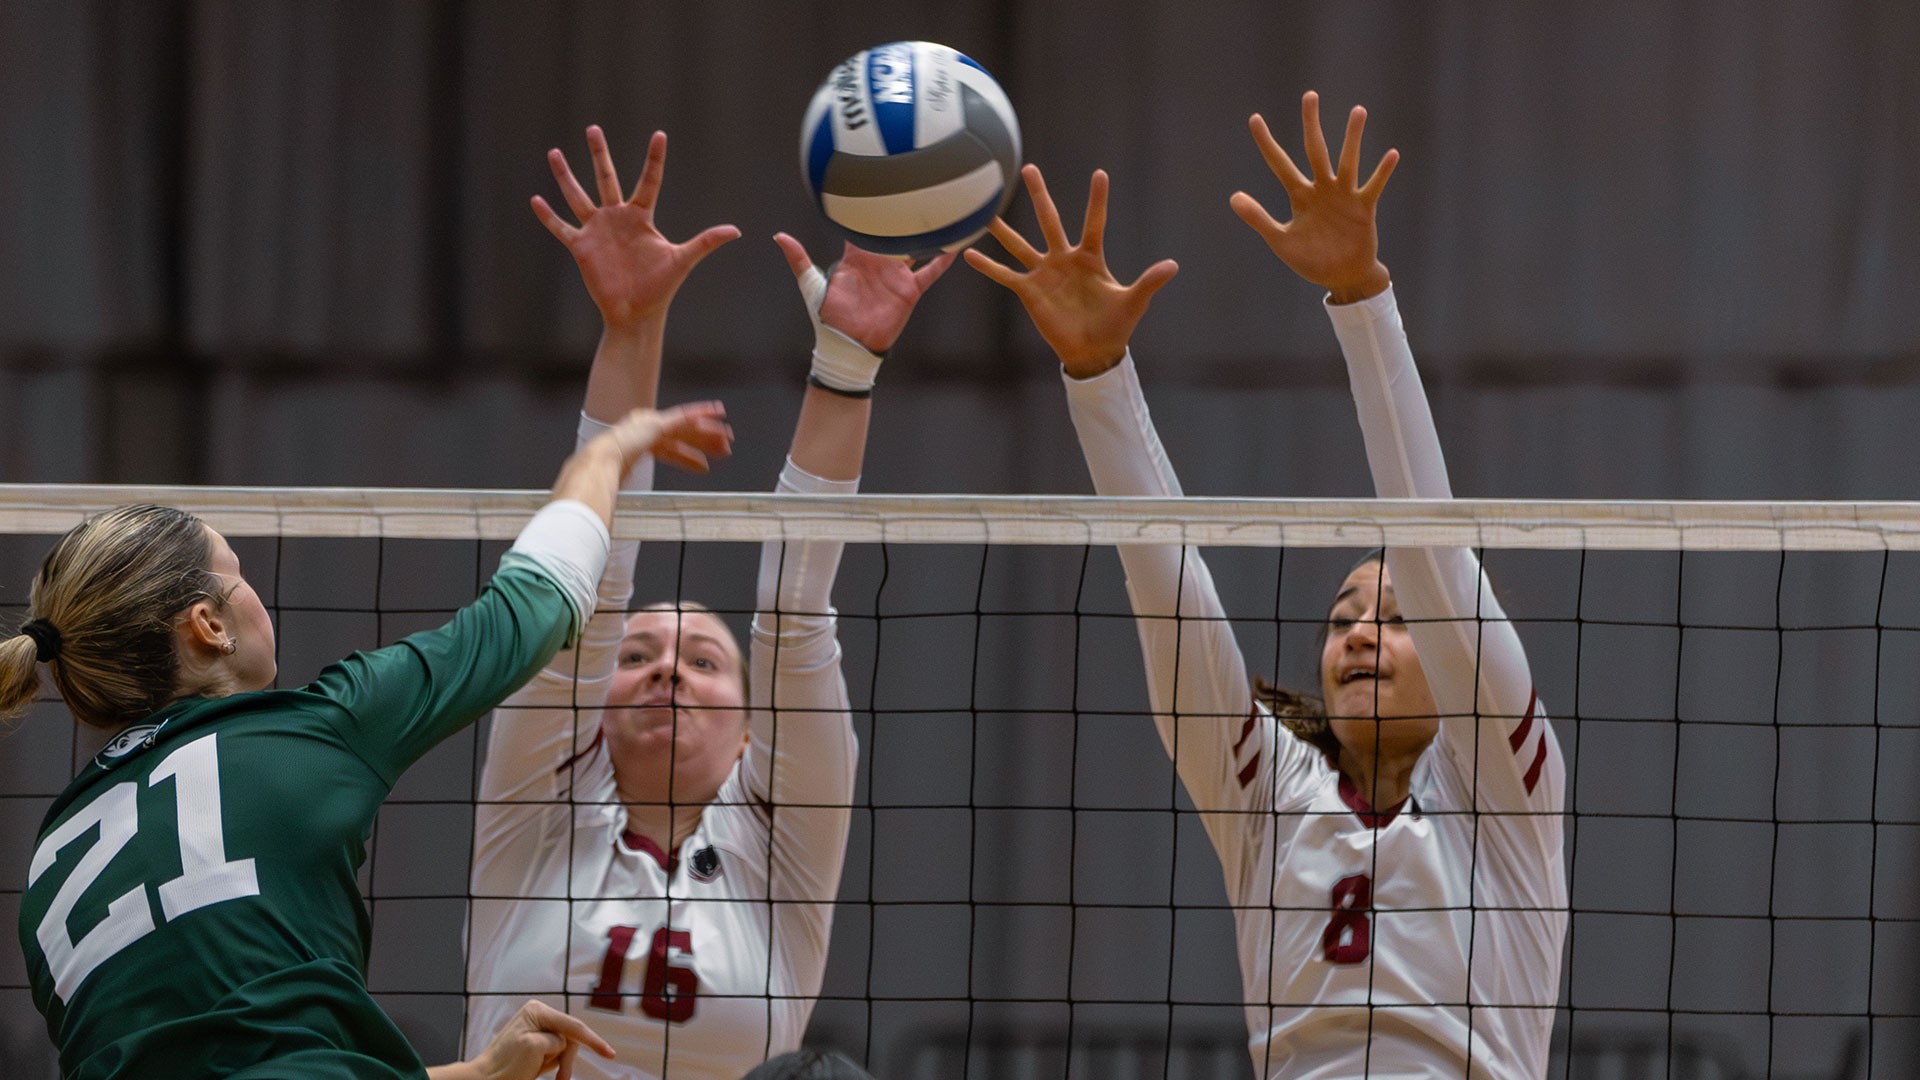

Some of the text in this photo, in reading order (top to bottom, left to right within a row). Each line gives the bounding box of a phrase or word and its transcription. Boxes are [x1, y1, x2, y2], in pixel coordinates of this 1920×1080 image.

[28, 732, 260, 1007] 21
[1323, 873, 1371, 964] 8
[588, 924, 698, 1025] 16
